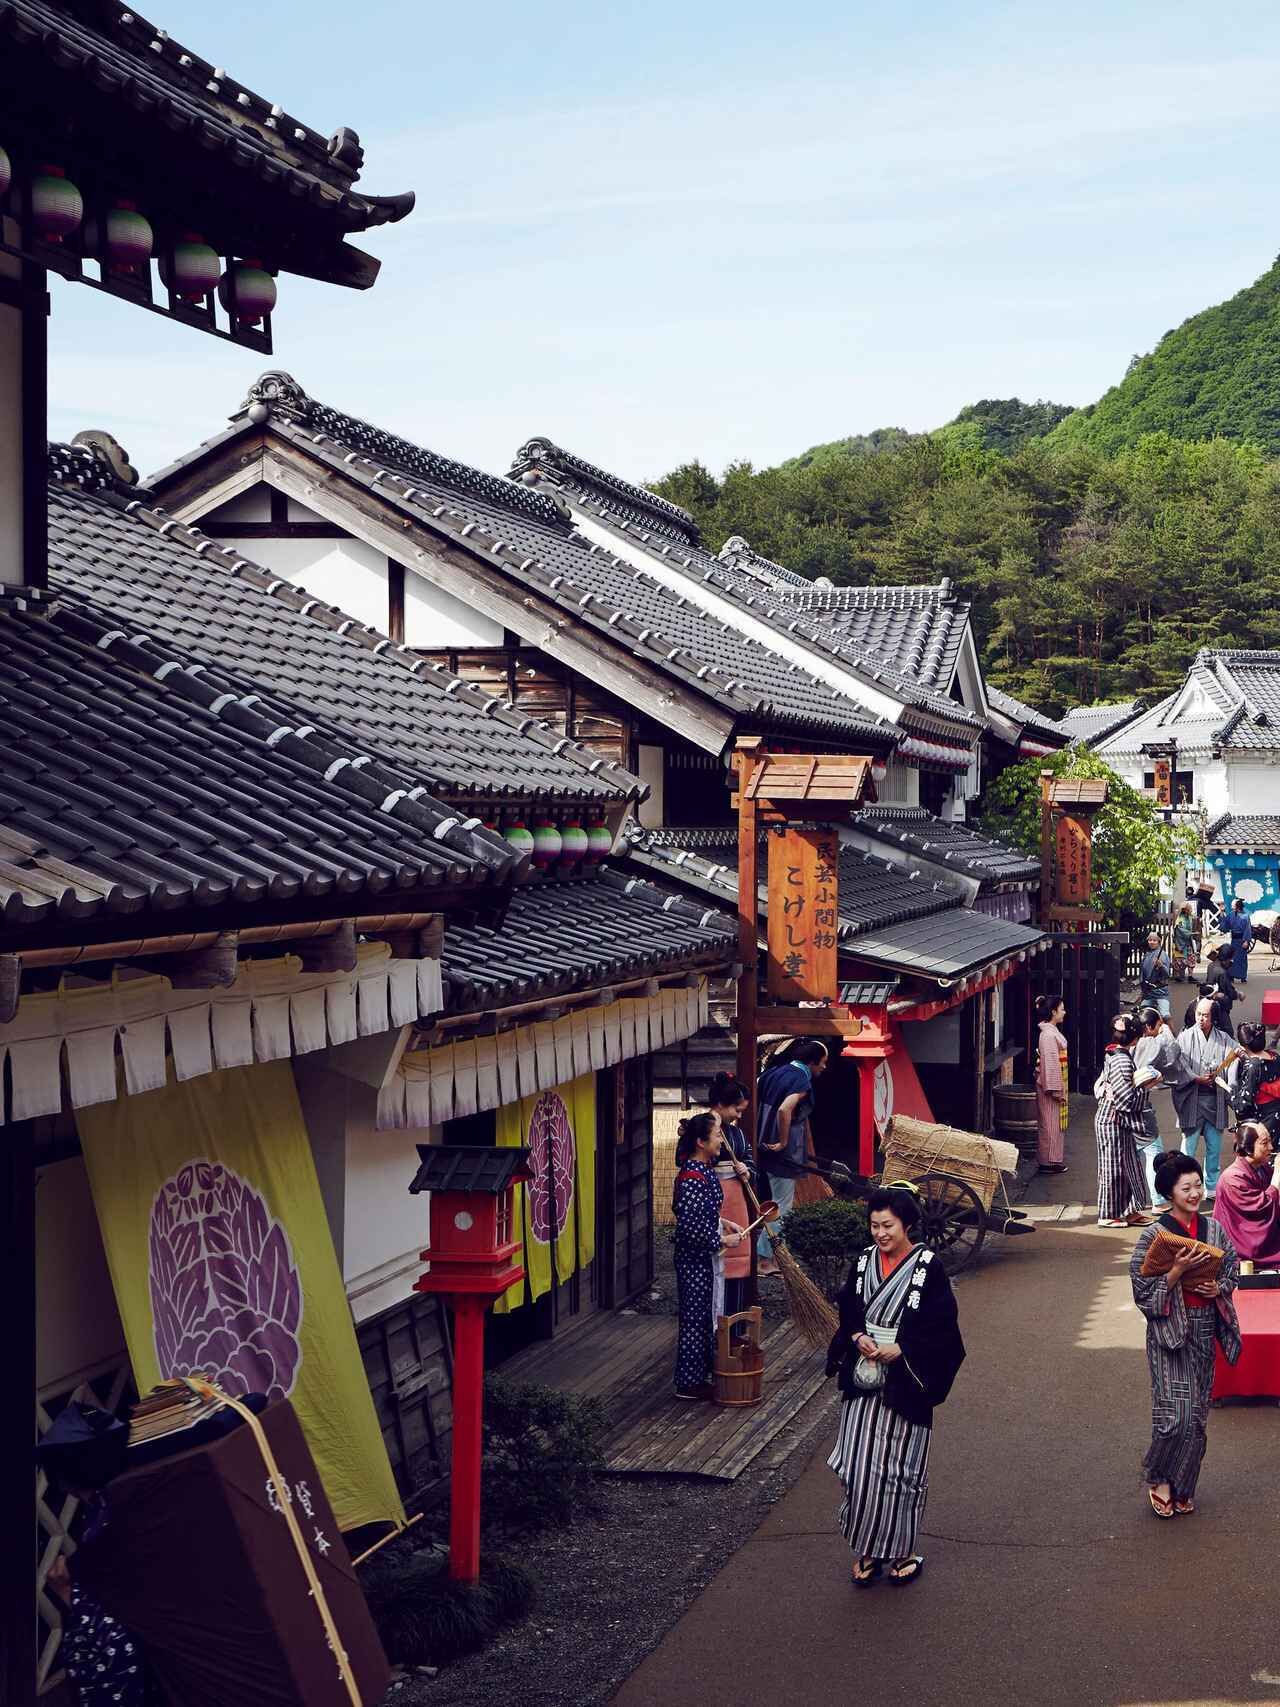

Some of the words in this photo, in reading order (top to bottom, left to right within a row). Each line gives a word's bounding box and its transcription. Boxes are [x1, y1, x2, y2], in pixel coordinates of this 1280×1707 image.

[783, 866, 807, 980] こけし堂
[813, 843, 836, 950] 民芸小間物
